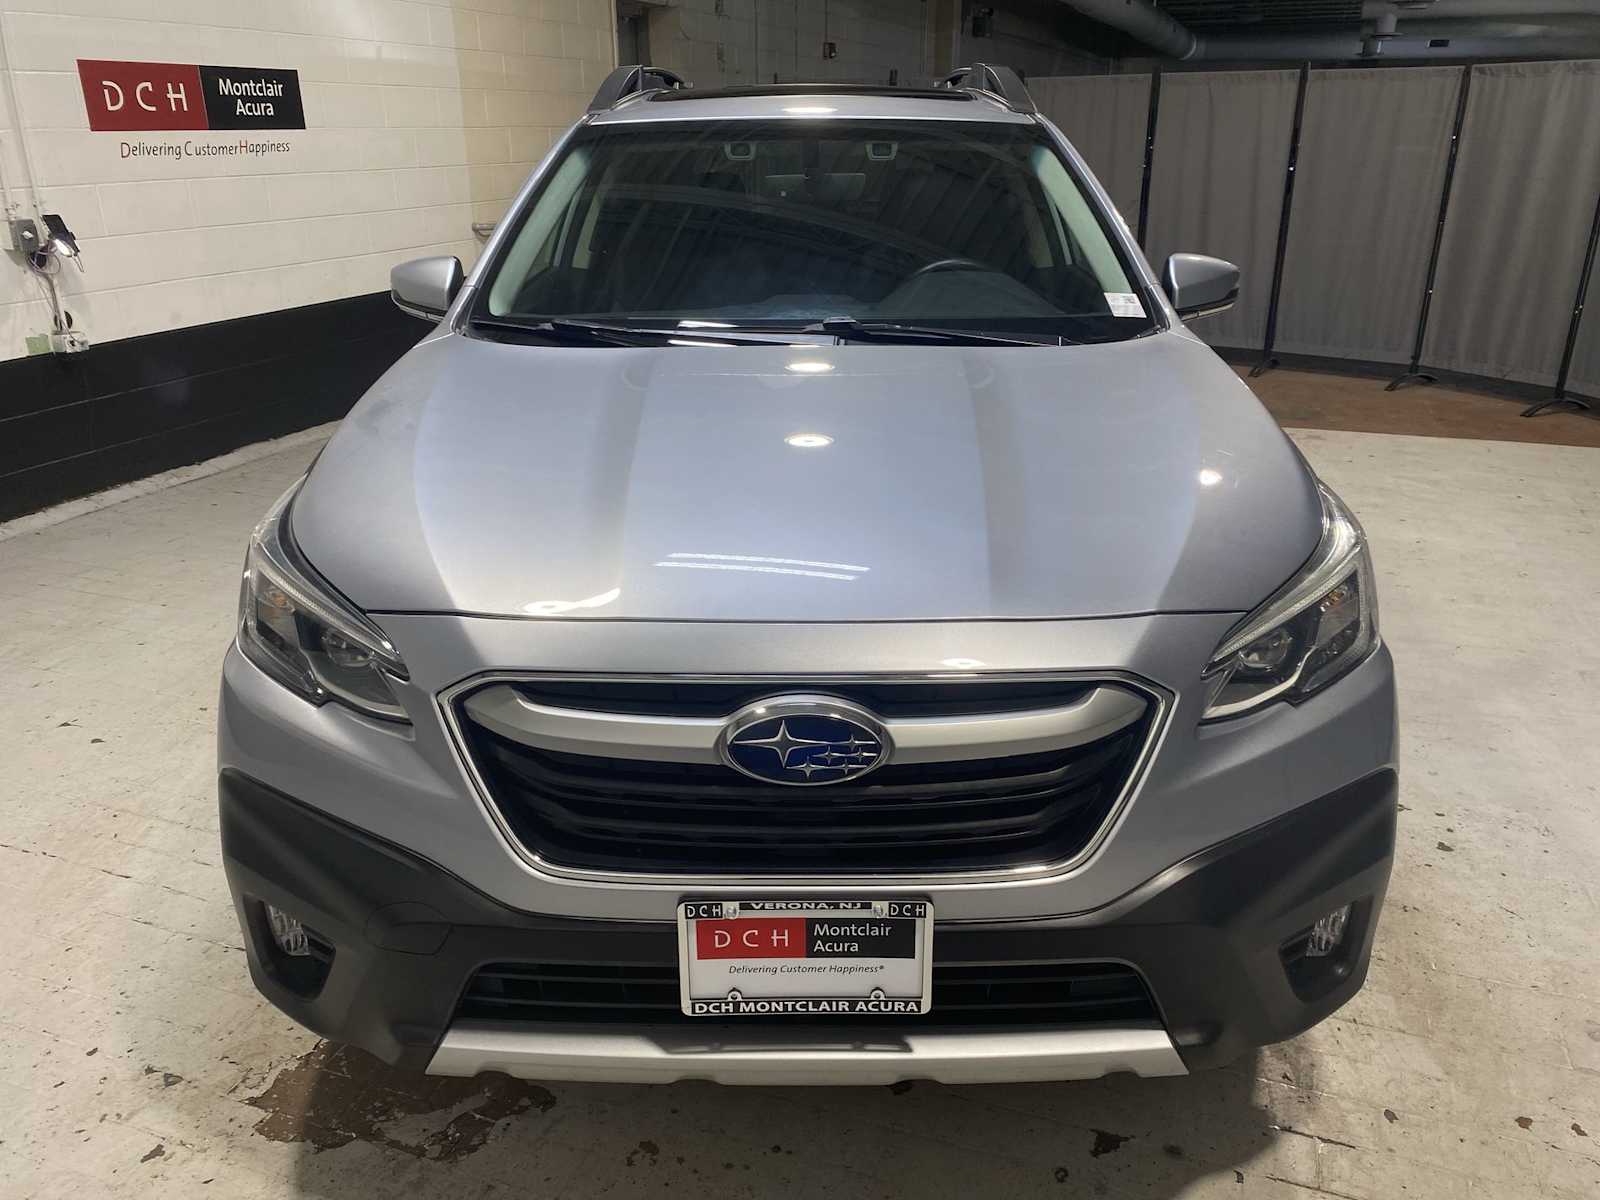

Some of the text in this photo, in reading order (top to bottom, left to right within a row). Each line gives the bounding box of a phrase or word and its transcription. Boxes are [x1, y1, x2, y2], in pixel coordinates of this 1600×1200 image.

[218, 78, 283, 97] Montclair
[235, 98, 274, 116] Acura
[120, 139, 290, 160] Delivering Customer Happiness
[687, 905, 722, 918] DCH
[751, 902, 862, 910] VERONA, NJ
[890, 904, 925, 917] DCH
[813, 923, 892, 937] Montclair
[813, 939, 859, 953] Acura
[729, 964, 777, 976] Delivering
[780, 964, 826, 974] Customer
[695, 1001, 918, 1014] DCH MONTCLAIR ACURA
